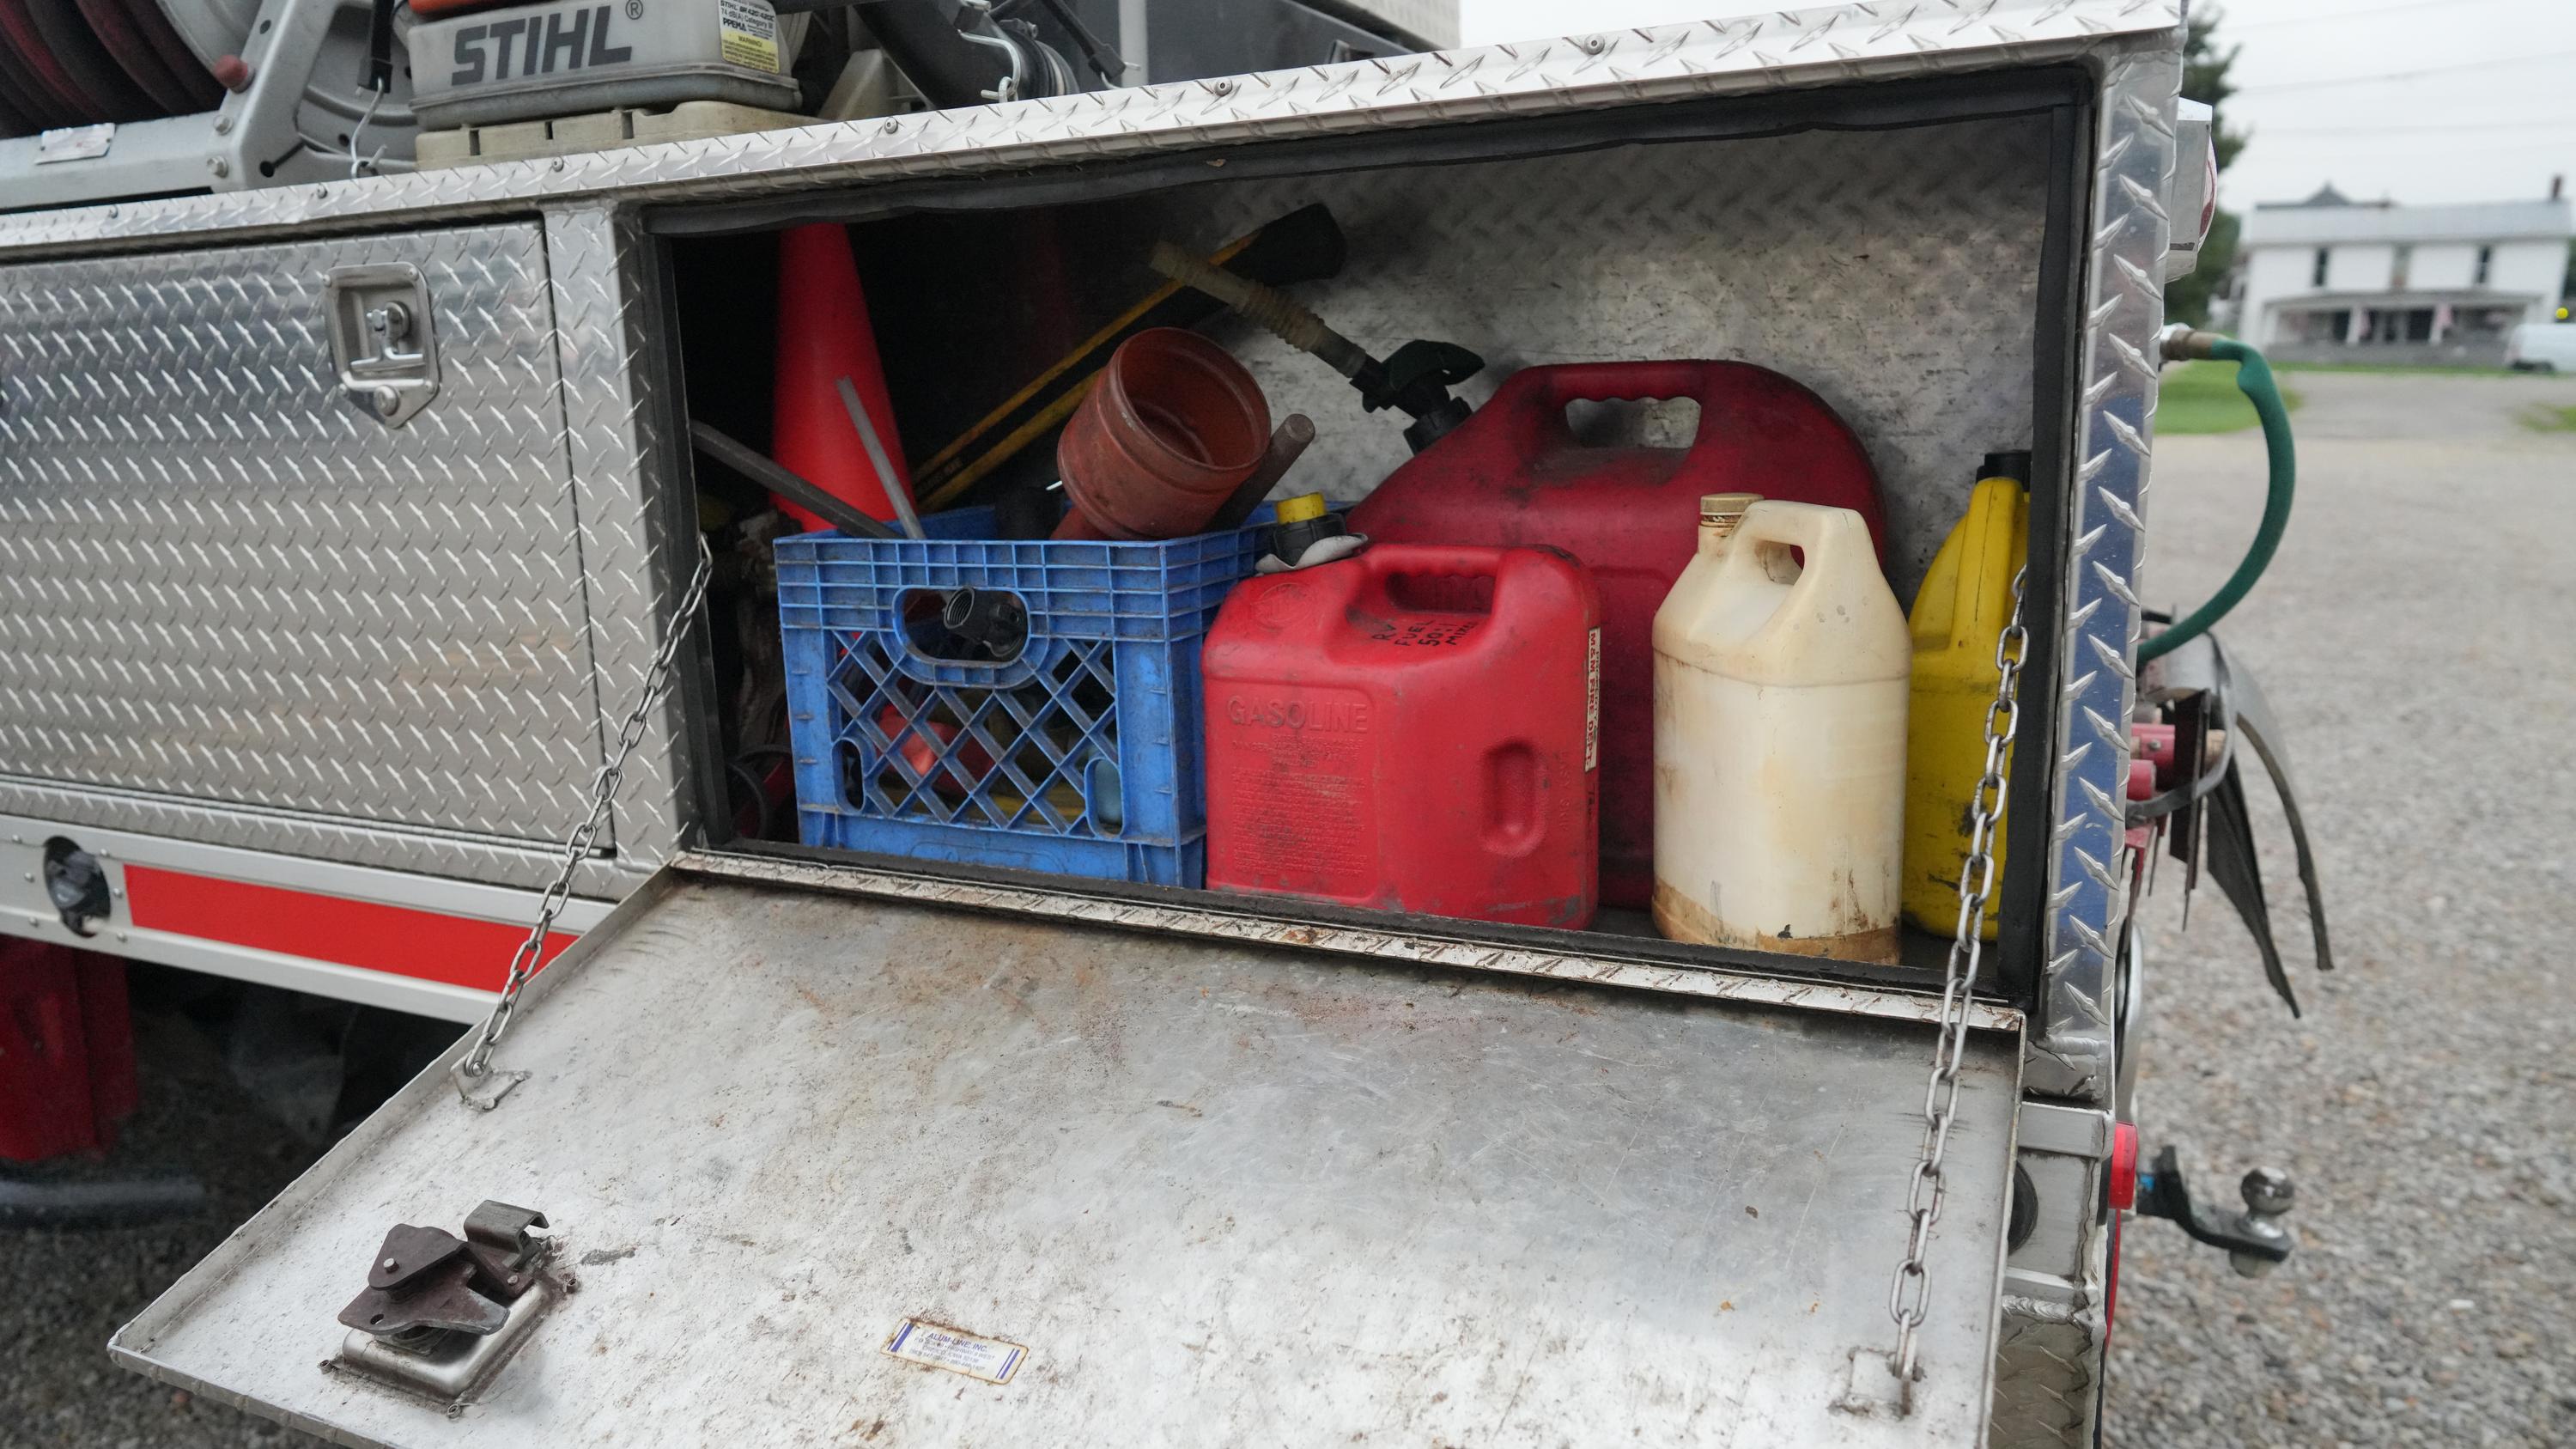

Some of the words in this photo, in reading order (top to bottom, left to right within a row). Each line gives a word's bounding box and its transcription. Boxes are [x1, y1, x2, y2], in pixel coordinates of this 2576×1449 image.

[452, 5, 633, 87] STIHL
[1394, 619, 1436, 646] FUEL
[1227, 695, 1368, 734] GASOLINE
